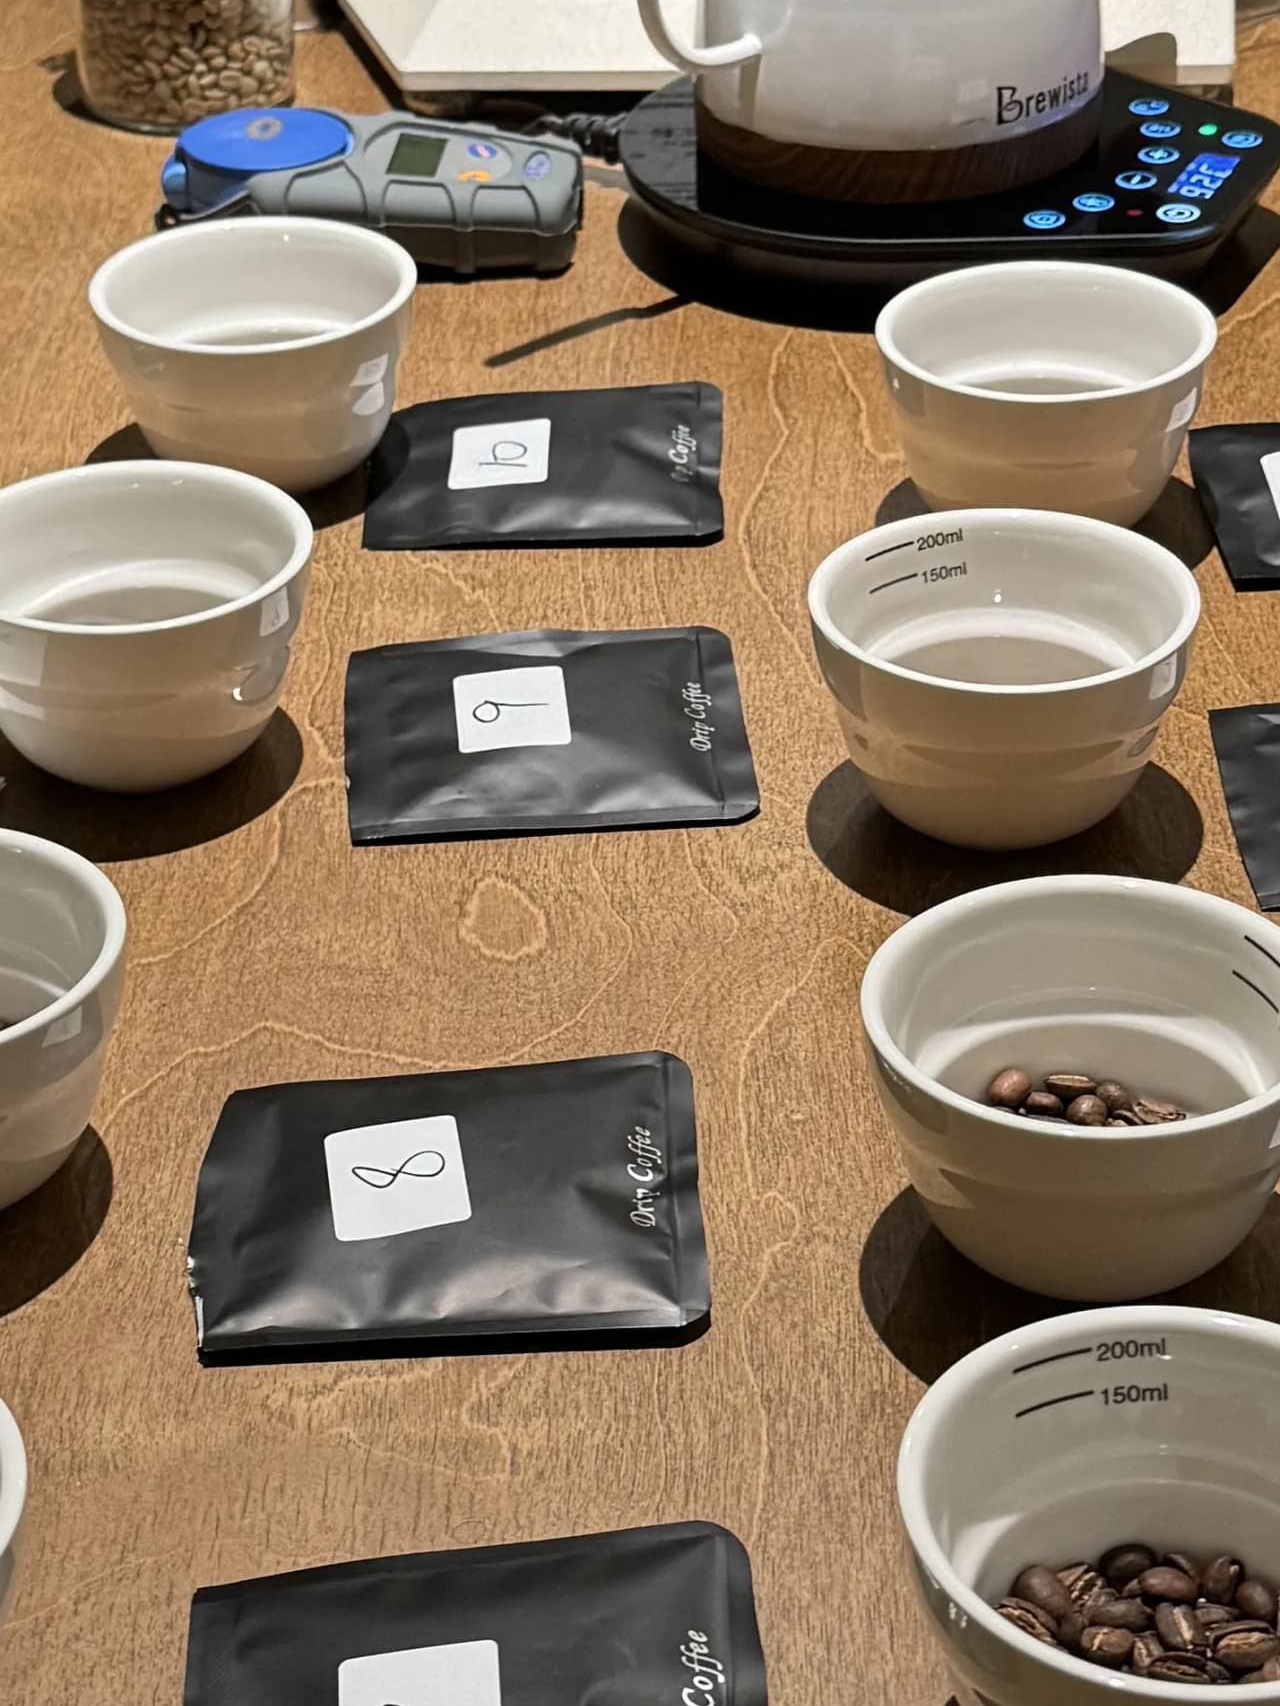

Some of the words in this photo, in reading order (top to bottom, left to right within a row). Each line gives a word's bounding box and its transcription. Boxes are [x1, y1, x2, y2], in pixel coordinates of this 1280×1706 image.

[996, 71, 1089, 125] Brewista
[916, 528, 964, 551] 200ml
[921, 561, 968, 584] 150ml
[472, 699, 550, 723] 9
[681, 681, 712, 718] Coffee
[690, 717, 715, 752] Drip
[627, 1125, 664, 1183] Coffee
[1096, 1338, 1167, 1362] 200ml
[1100, 1383, 1169, 1405] 150ml
